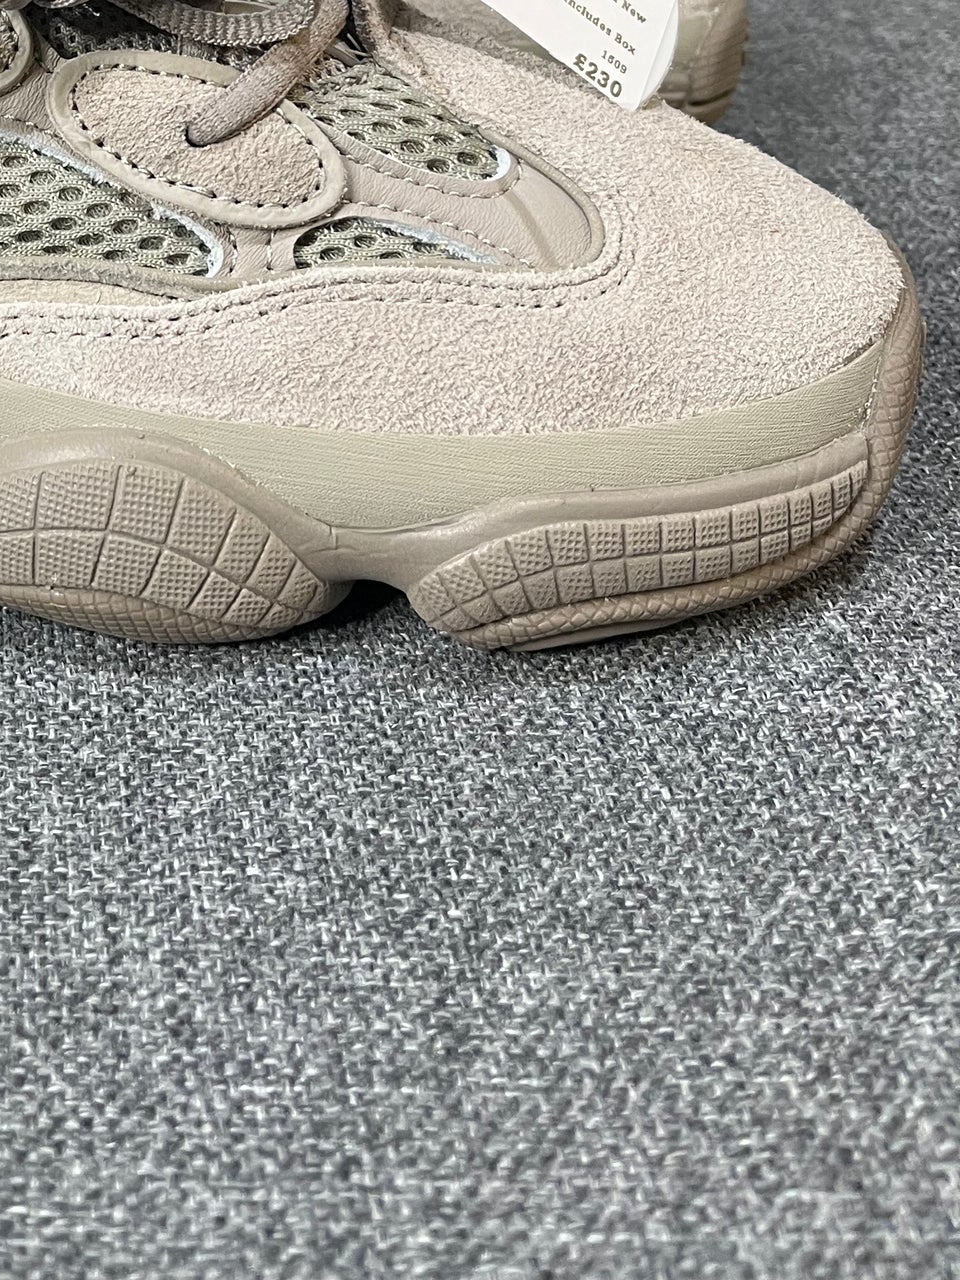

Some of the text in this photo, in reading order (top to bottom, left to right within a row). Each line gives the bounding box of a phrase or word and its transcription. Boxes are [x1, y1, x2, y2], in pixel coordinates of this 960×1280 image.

[621, 0, 647, 24] New
[614, 32, 637, 55] Box
[572, 53, 622, 98] £230
